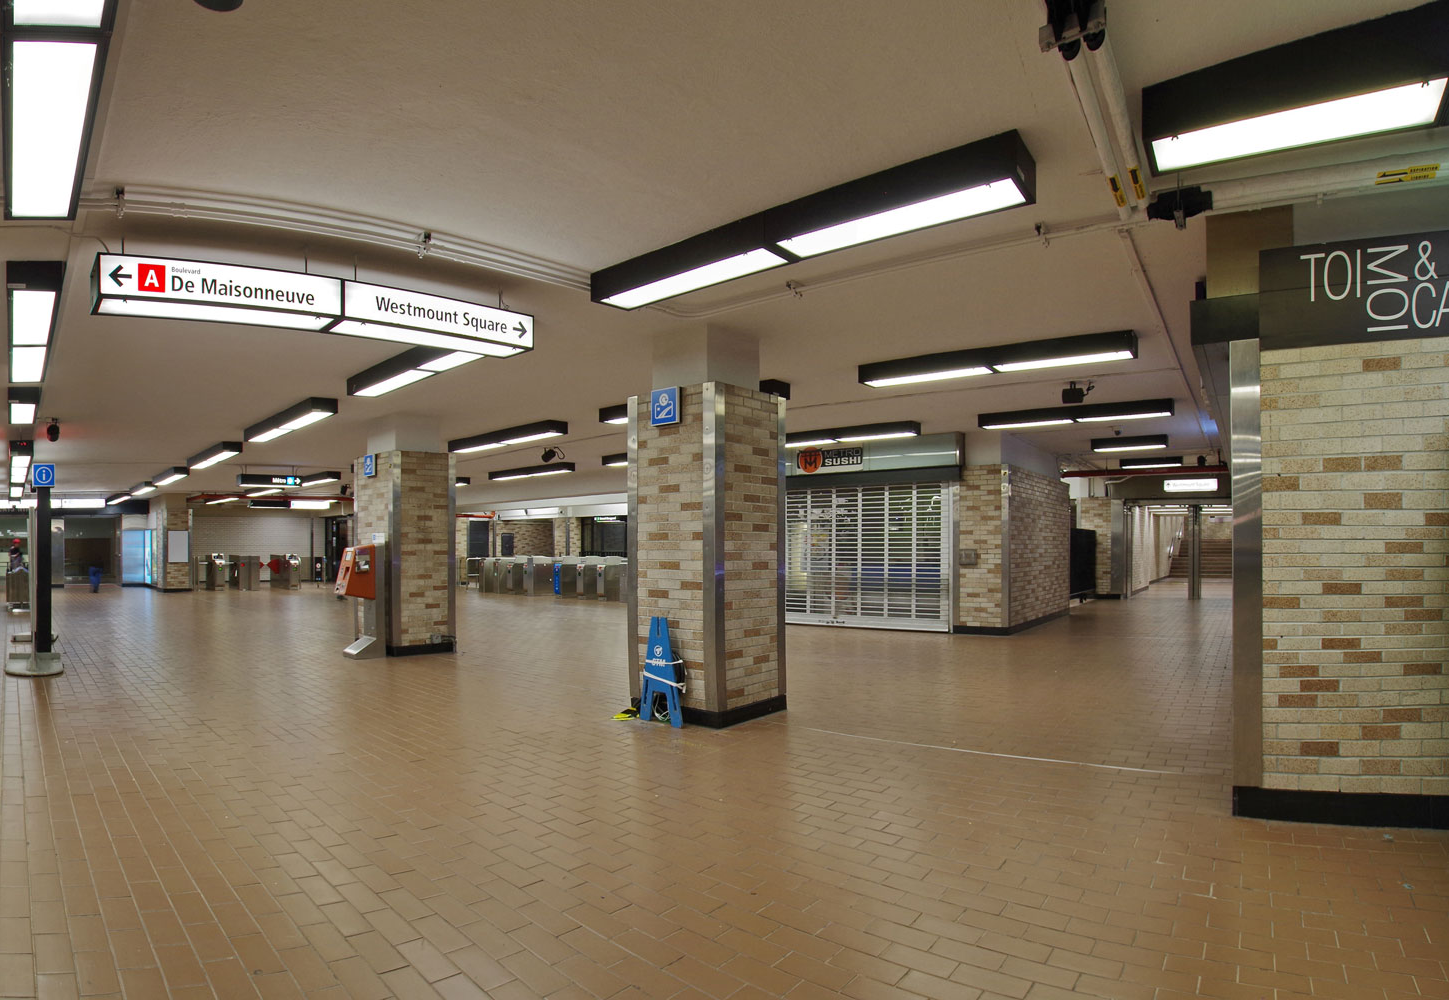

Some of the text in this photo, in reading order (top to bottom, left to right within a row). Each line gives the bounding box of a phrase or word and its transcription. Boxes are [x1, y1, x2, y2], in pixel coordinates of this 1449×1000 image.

[171, 266, 201, 275] Boulevard
[1300, 249, 1361, 302] TOI
[1414, 240, 1439, 281] &
[144, 269, 159, 288] A
[171, 275, 315, 306] De Maisonneuve
[1366, 244, 1409, 332] MOI
[375, 295, 508, 333] Westmount Square
[824, 446, 862, 458] METRO
[824, 457, 862, 466] SUSHI
